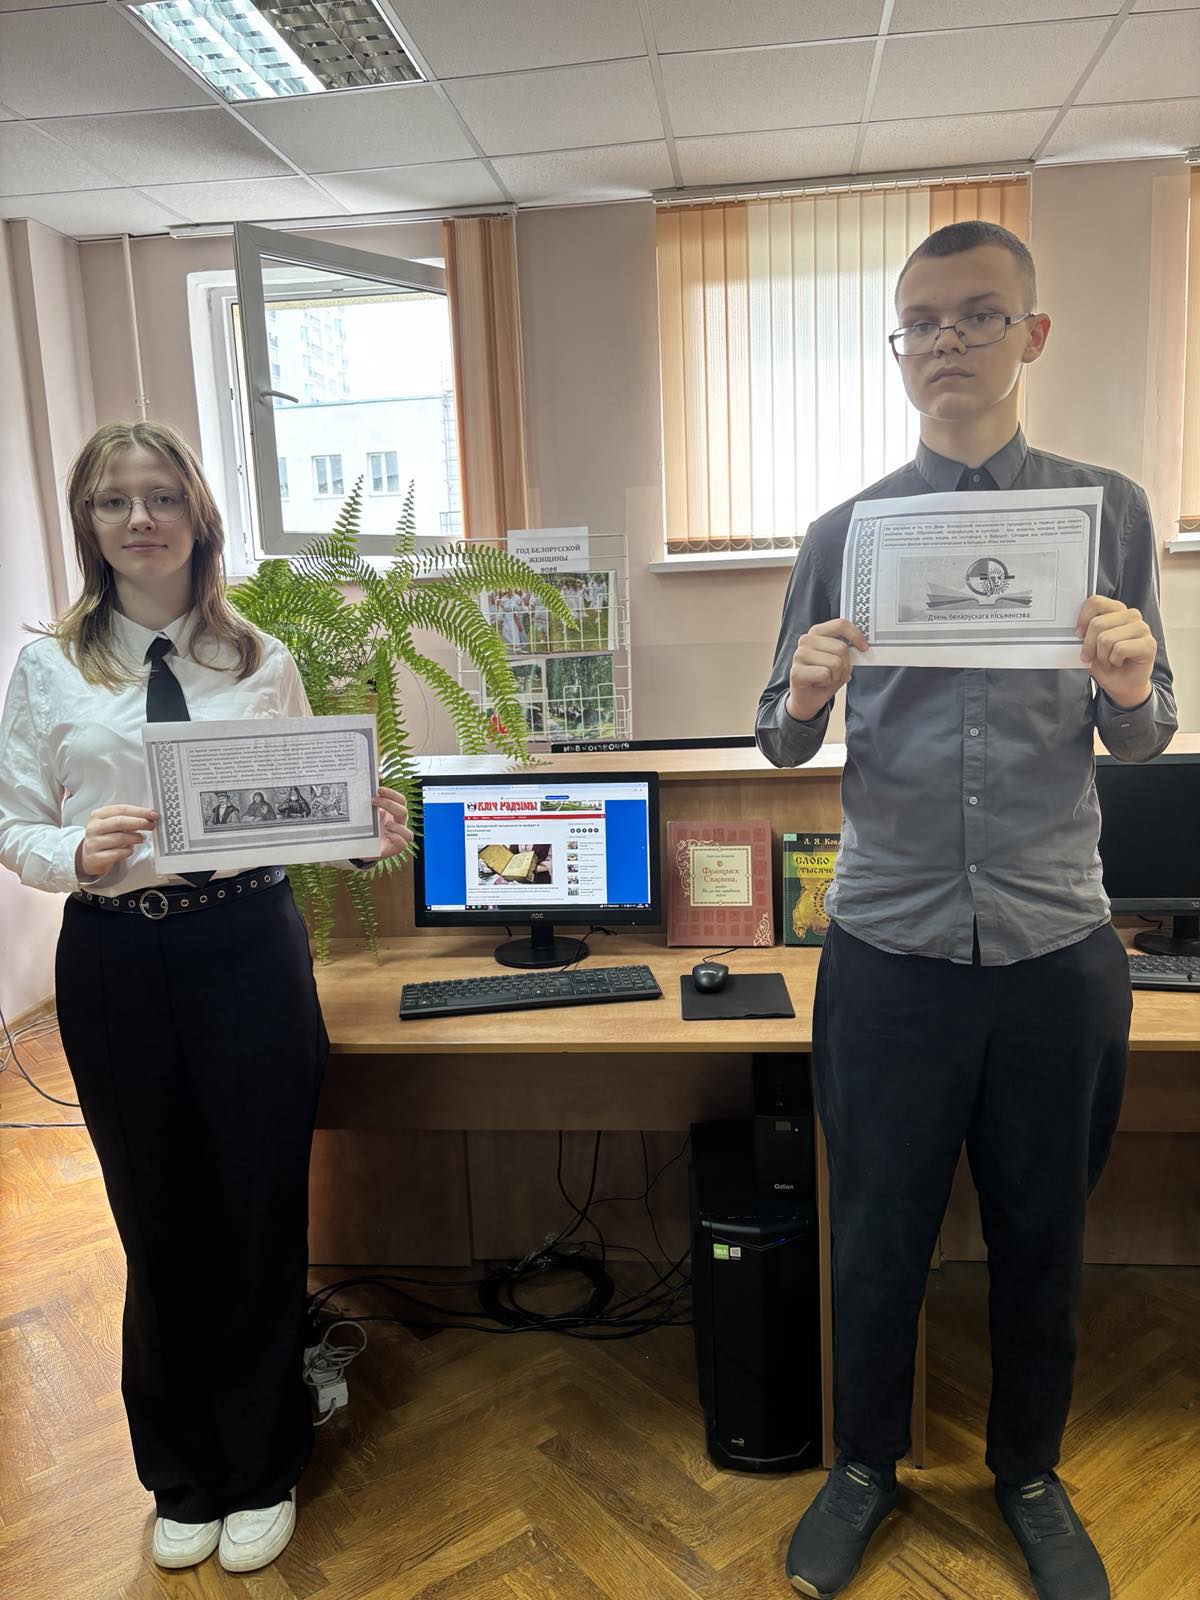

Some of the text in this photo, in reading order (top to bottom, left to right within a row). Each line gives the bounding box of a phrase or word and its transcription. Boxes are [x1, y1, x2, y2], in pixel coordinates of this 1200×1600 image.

[531, 544, 580, 554] БЕЛОРУССКОЙ
[927, 614, 948, 622] Дзень
[796, 857, 830, 865] СЛОВО
